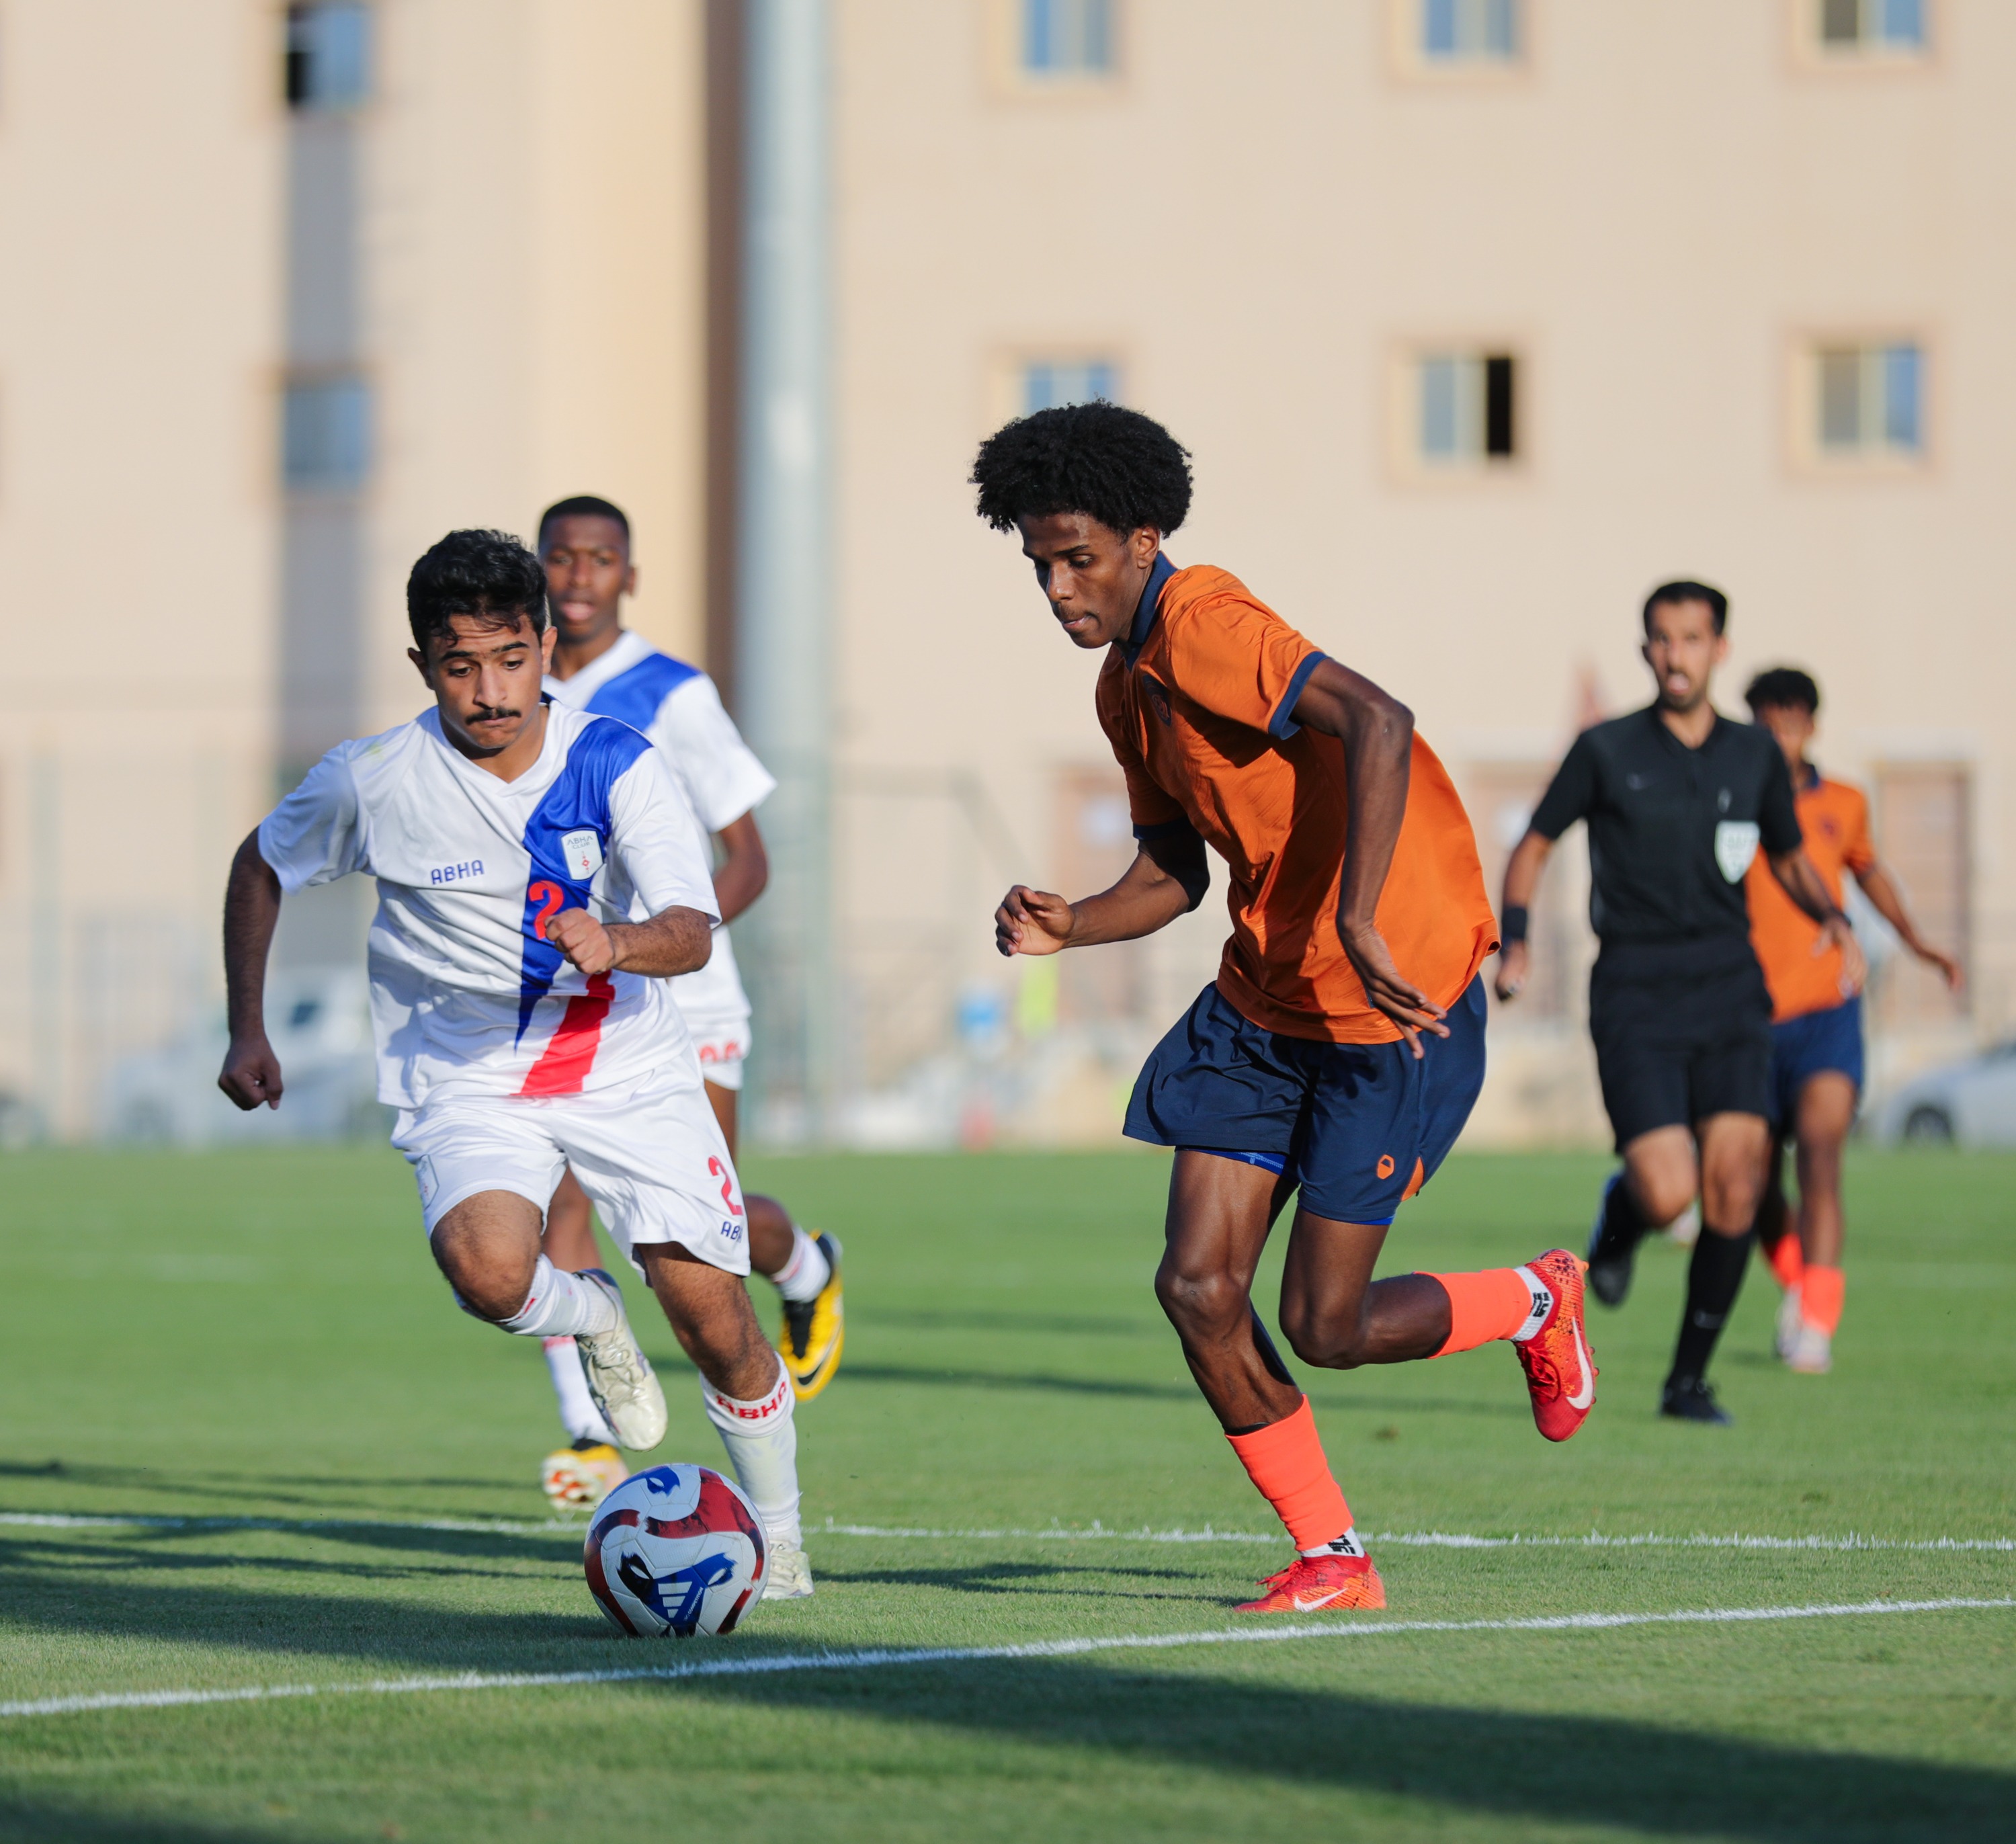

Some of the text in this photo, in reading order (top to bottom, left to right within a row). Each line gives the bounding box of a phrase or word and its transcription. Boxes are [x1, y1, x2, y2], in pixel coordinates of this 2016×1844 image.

[566, 835, 593, 845] ABHA
[431, 860, 485, 886] ABHA
[529, 880, 564, 940] 2
[708, 1155, 743, 1216] 2
